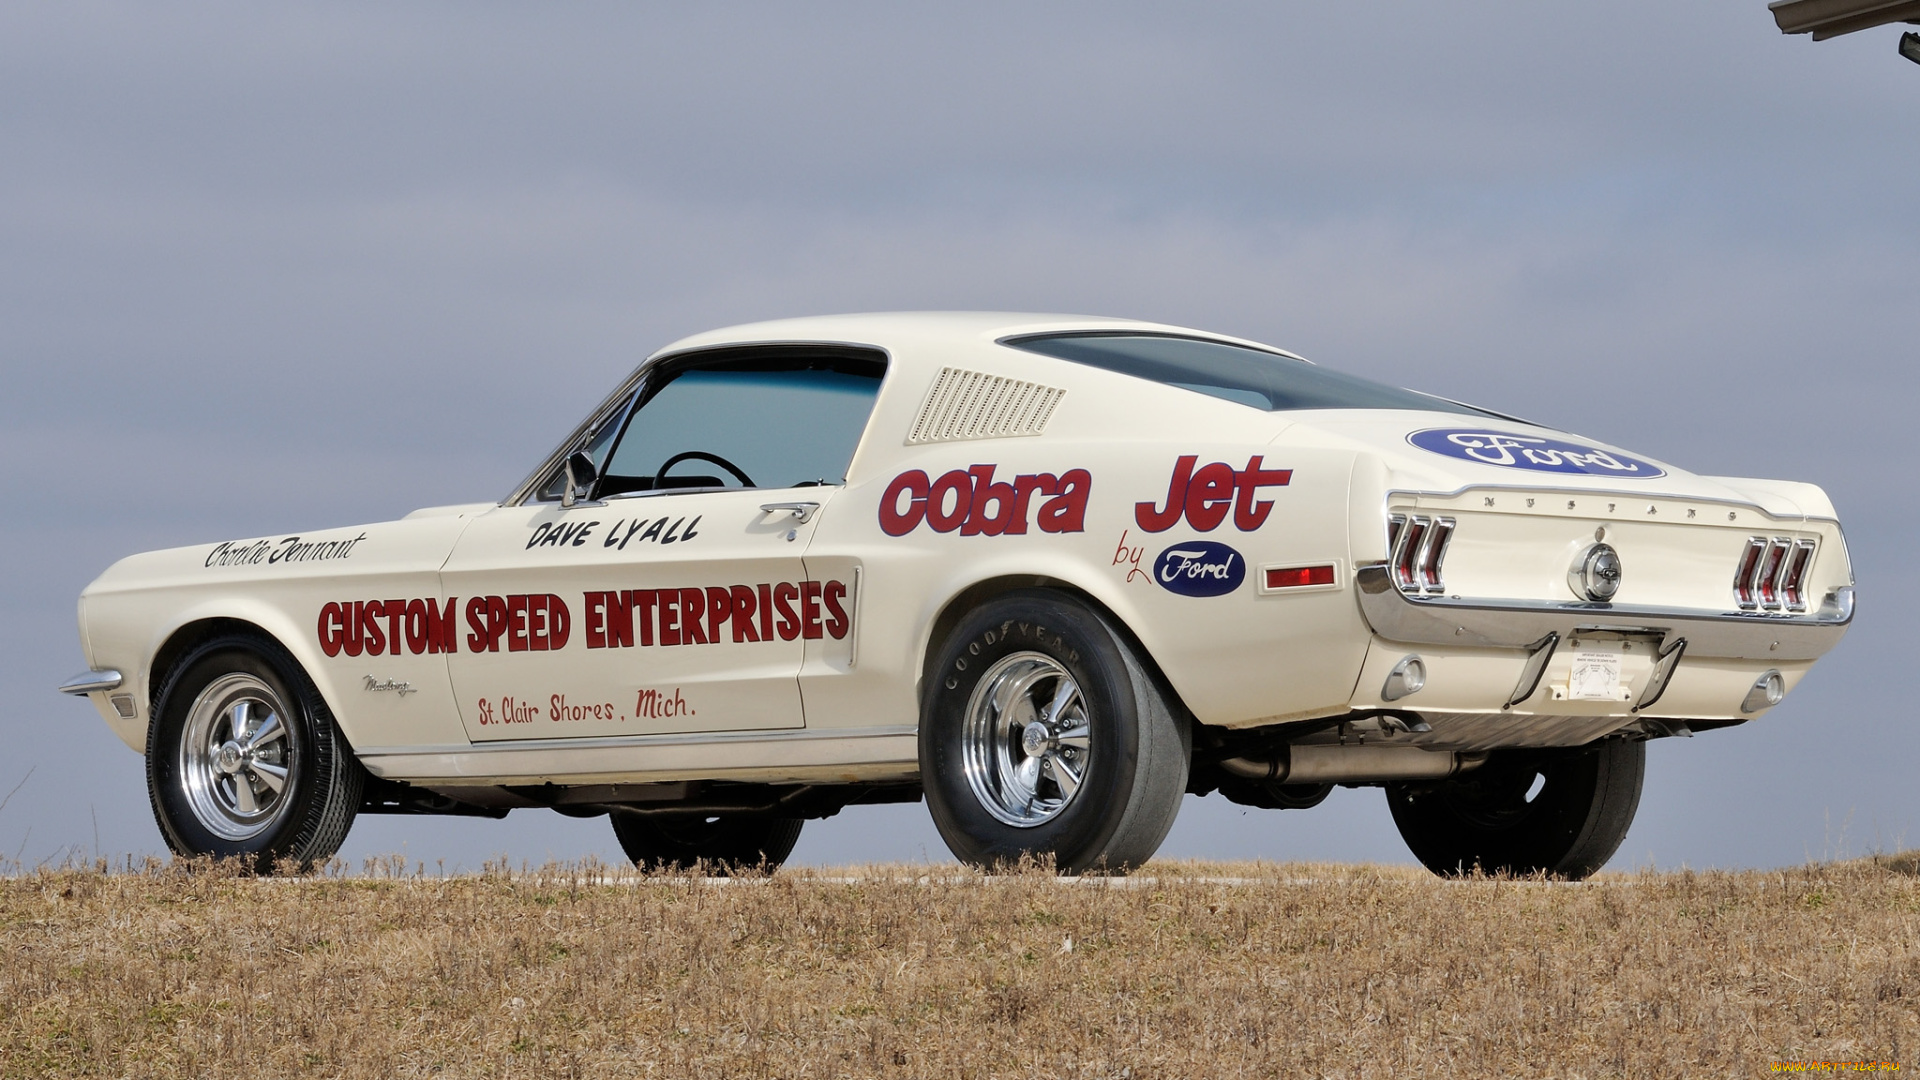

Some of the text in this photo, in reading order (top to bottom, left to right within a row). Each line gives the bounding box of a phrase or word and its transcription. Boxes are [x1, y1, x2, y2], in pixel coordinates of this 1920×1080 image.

[1448, 433, 1638, 472] Ford
[1135, 454, 1294, 533] Jet
[1484, 497, 1737, 521] MUSTANG
[526, 515, 702, 550] DAVE LYALL
[205, 541, 271, 568] Charlie
[1112, 529, 1231, 584] by Ford
[318, 580, 849, 657] CUSTOM SPEED ENTERPRISES
[945, 620, 1081, 690] GOODYEAR
[362, 674, 418, 697] Mustang
[478, 698, 500, 725] St.
[501, 695, 539, 724] Clair
[635, 688, 696, 719] Mich.
